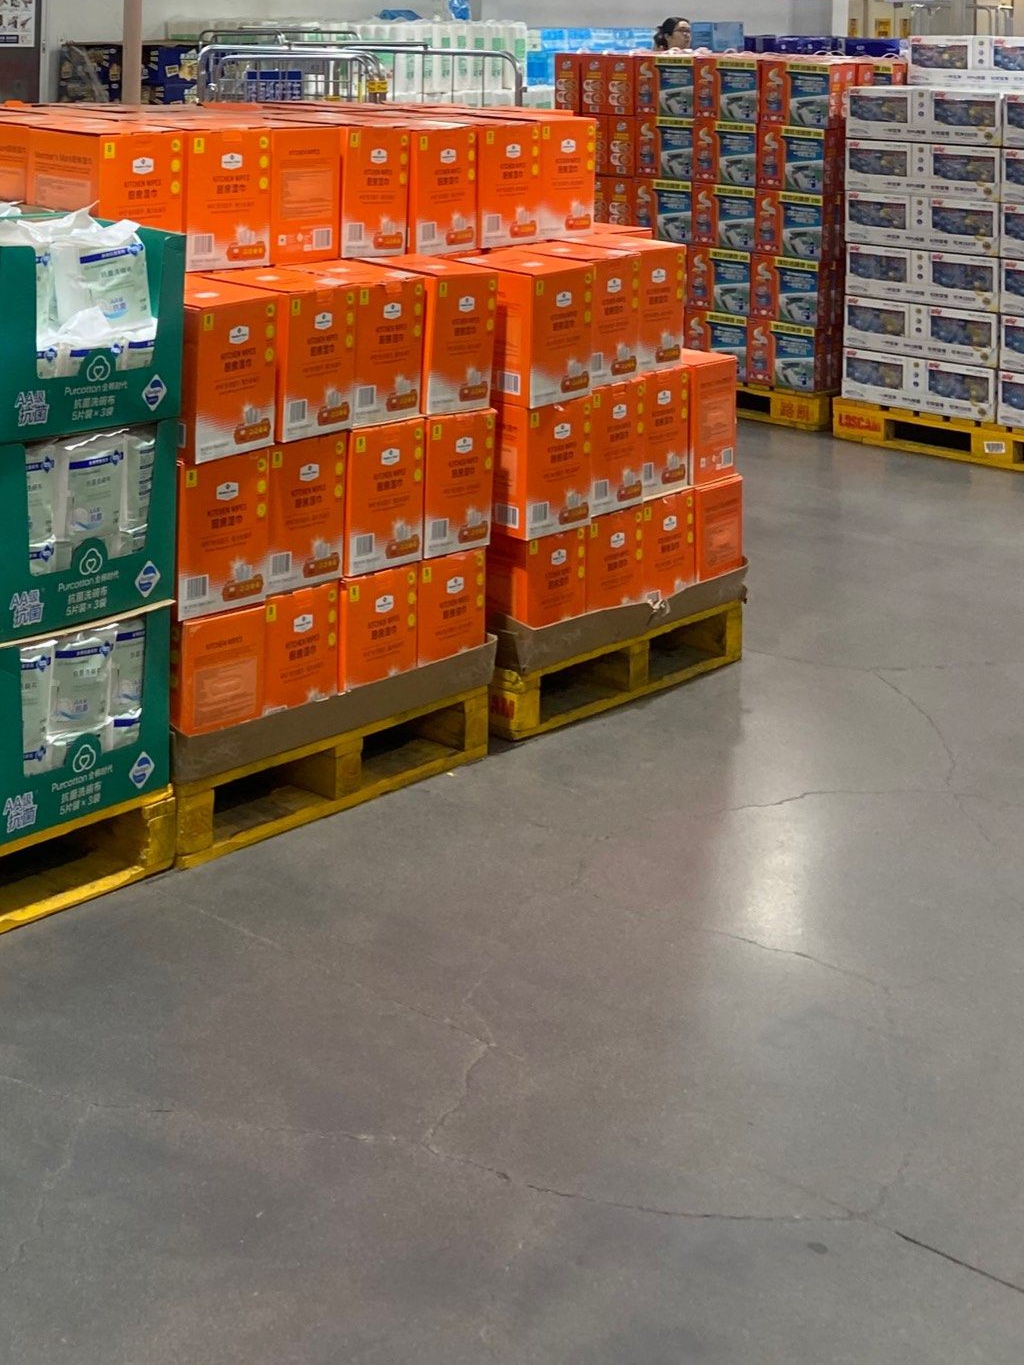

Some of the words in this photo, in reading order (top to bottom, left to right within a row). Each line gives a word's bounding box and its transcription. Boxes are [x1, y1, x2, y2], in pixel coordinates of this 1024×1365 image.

[14, 390, 46, 408] AA级
[64, 385, 101, 396] Purcotton
[18, 403, 50, 427] 抗菌
[57, 578, 94, 592] Purcotton
[9, 589, 40, 610] AA级
[12, 604, 44, 628] 抗菌
[51, 775, 88, 792] Purcotton
[2, 791, 34, 815] AA级
[6, 806, 38, 833] 抗菌
